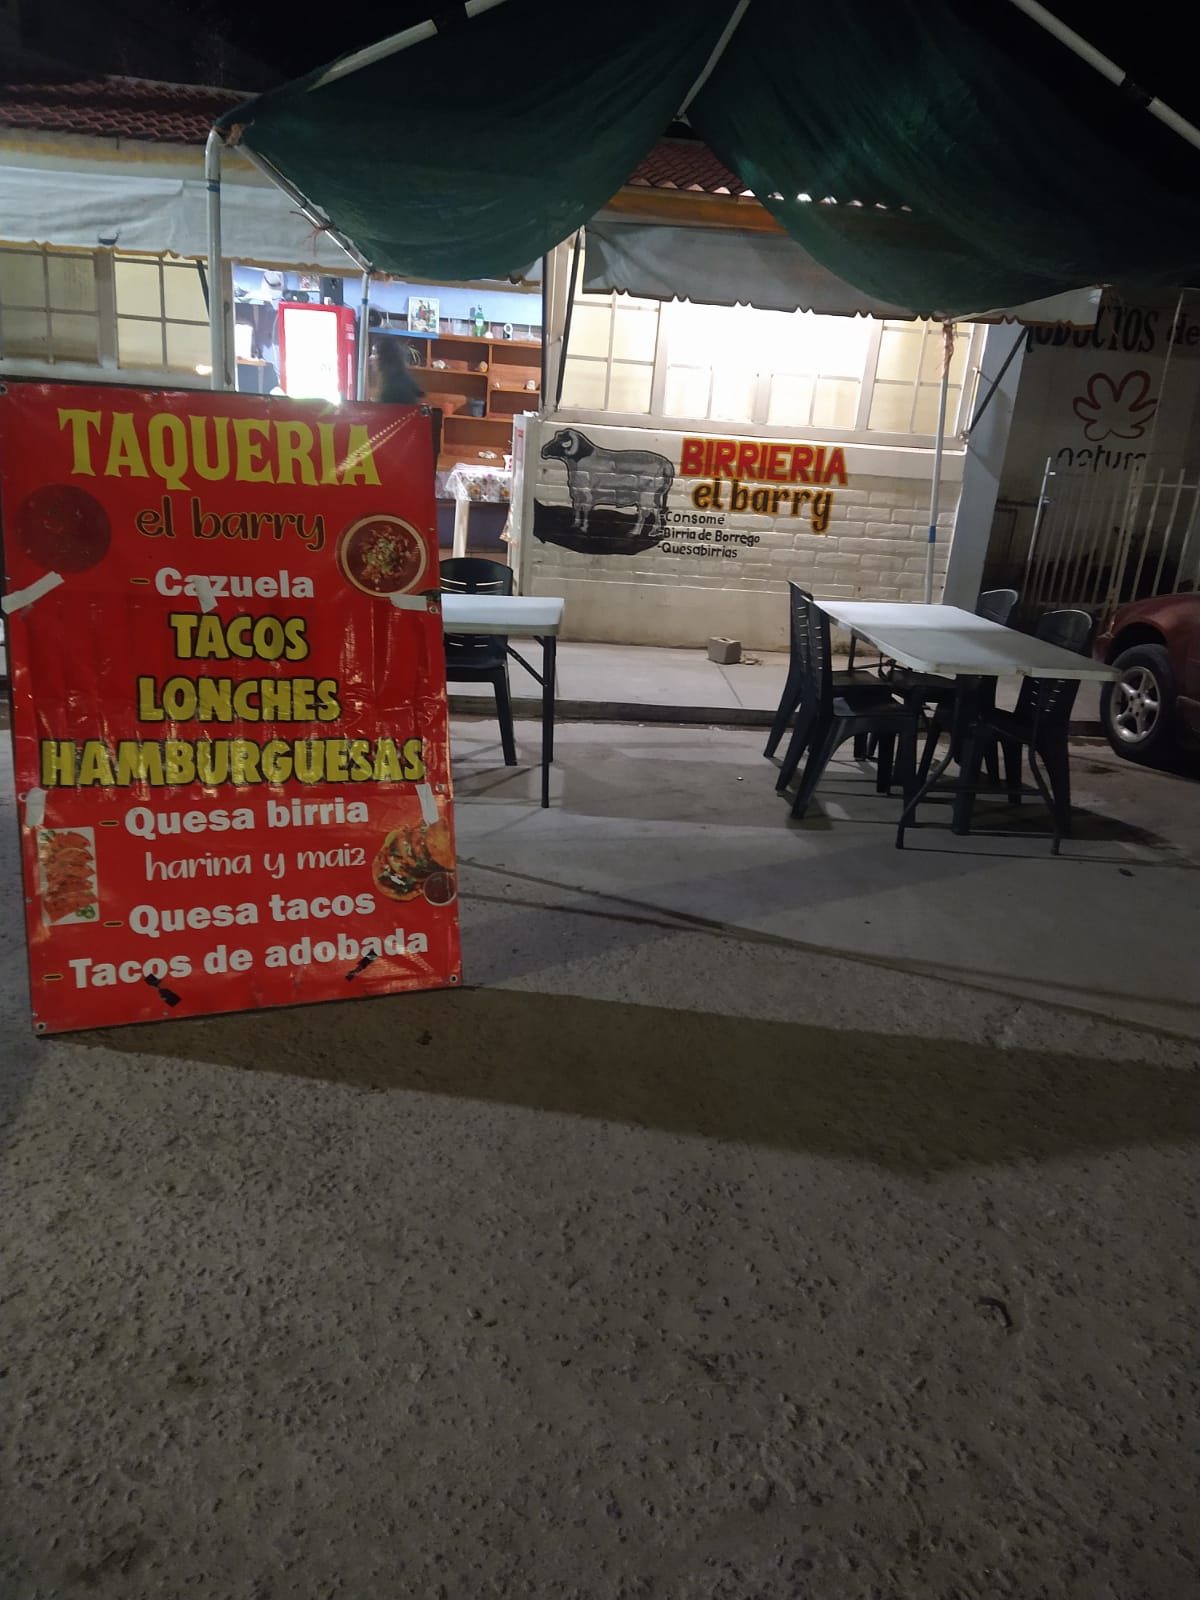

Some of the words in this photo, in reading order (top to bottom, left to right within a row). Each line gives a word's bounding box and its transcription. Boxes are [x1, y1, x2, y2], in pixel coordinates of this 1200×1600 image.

[680, 437, 848, 485] BIRRIERIA
[136, 496, 175, 538] el
[192, 497, 325, 550] barry
[691, 477, 723, 510] el
[730, 479, 833, 534] barry
[698, 529, 712, 541] de
[715, 530, 760, 547] Borrego
[169, 614, 311, 661] TACOS
[137, 676, 342, 722] LONCHES
[39, 737, 426, 787] HAMBURGUESAS
[125, 806, 255, 839] Quesa
[267, 797, 369, 828] birria
[145, 851, 252, 881] harina
[263, 854, 286, 880] y
[297, 843, 366, 871] maiz
[129, 903, 259, 938] Quesa
[269, 892, 375, 922] tacos
[69, 954, 193, 988] Tacos
[203, 944, 254, 975] de
[264, 927, 428, 966] adobada
